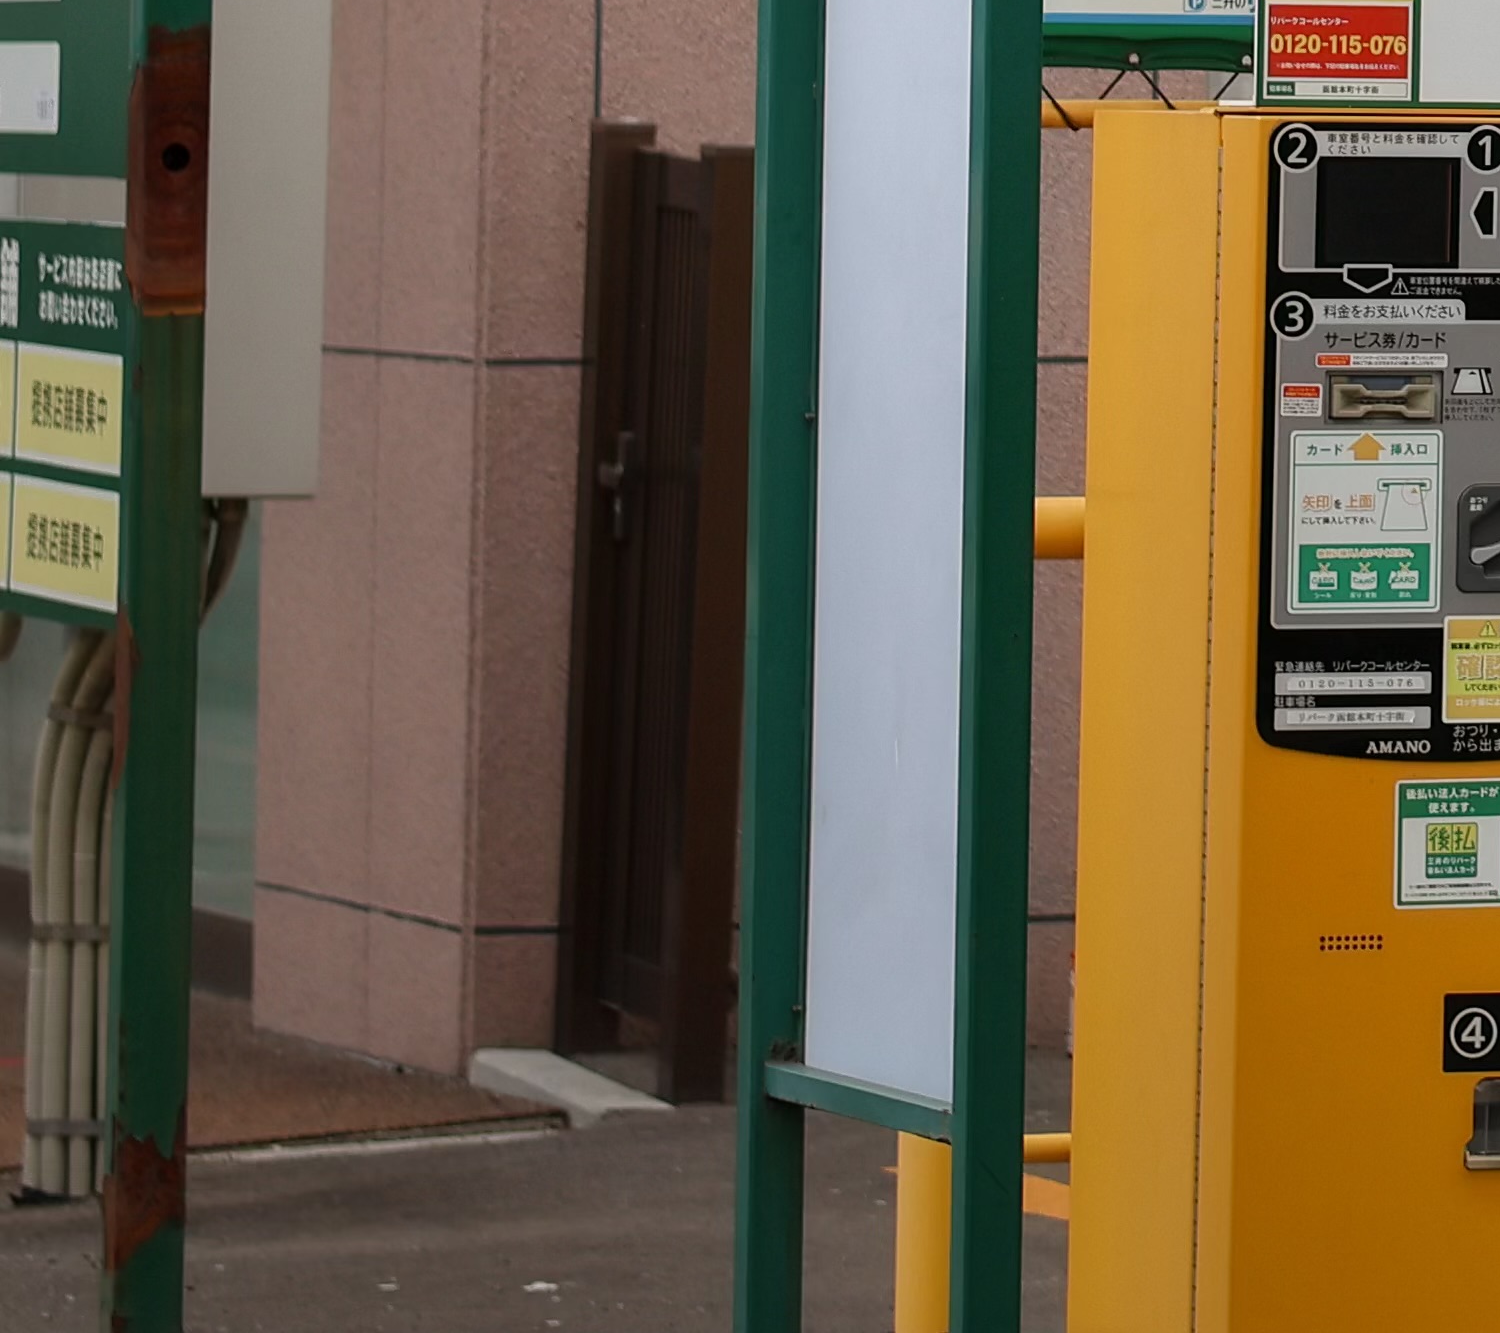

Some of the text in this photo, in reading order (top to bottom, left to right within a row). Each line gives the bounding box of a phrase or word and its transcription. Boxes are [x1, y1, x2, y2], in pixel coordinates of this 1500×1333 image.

[1271, 16, 1349, 26] リパークコールセンター
[1270, 34, 1407, 55] 0120-115-076
[1287, 132, 1460, 164] 2 車室番号と料金を確認して
[1327, 145, 1371, 155] ください
[1478, 135, 1493, 166] 1
[1283, 301, 1461, 332] 3 料金をお支払いください
[1307, 444, 1428, 456] カード 挿入口
[1274, 660, 1430, 672] 緊急連絡先 リパークコールセンター
[1298, 678, 1413, 688] 0120-115-076
[1274, 696, 1316, 708] 駐車場名
[1365, 740, 1432, 754] AMANO
[1406, 787, 1499, 800] 後払い法人カードが
[1428, 802, 1475, 813] 使えます。
[1429, 826, 1475, 851] 後払
[1427, 856, 1476, 866] 三井のリパーク
[1461, 1016, 1486, 1049] 4
